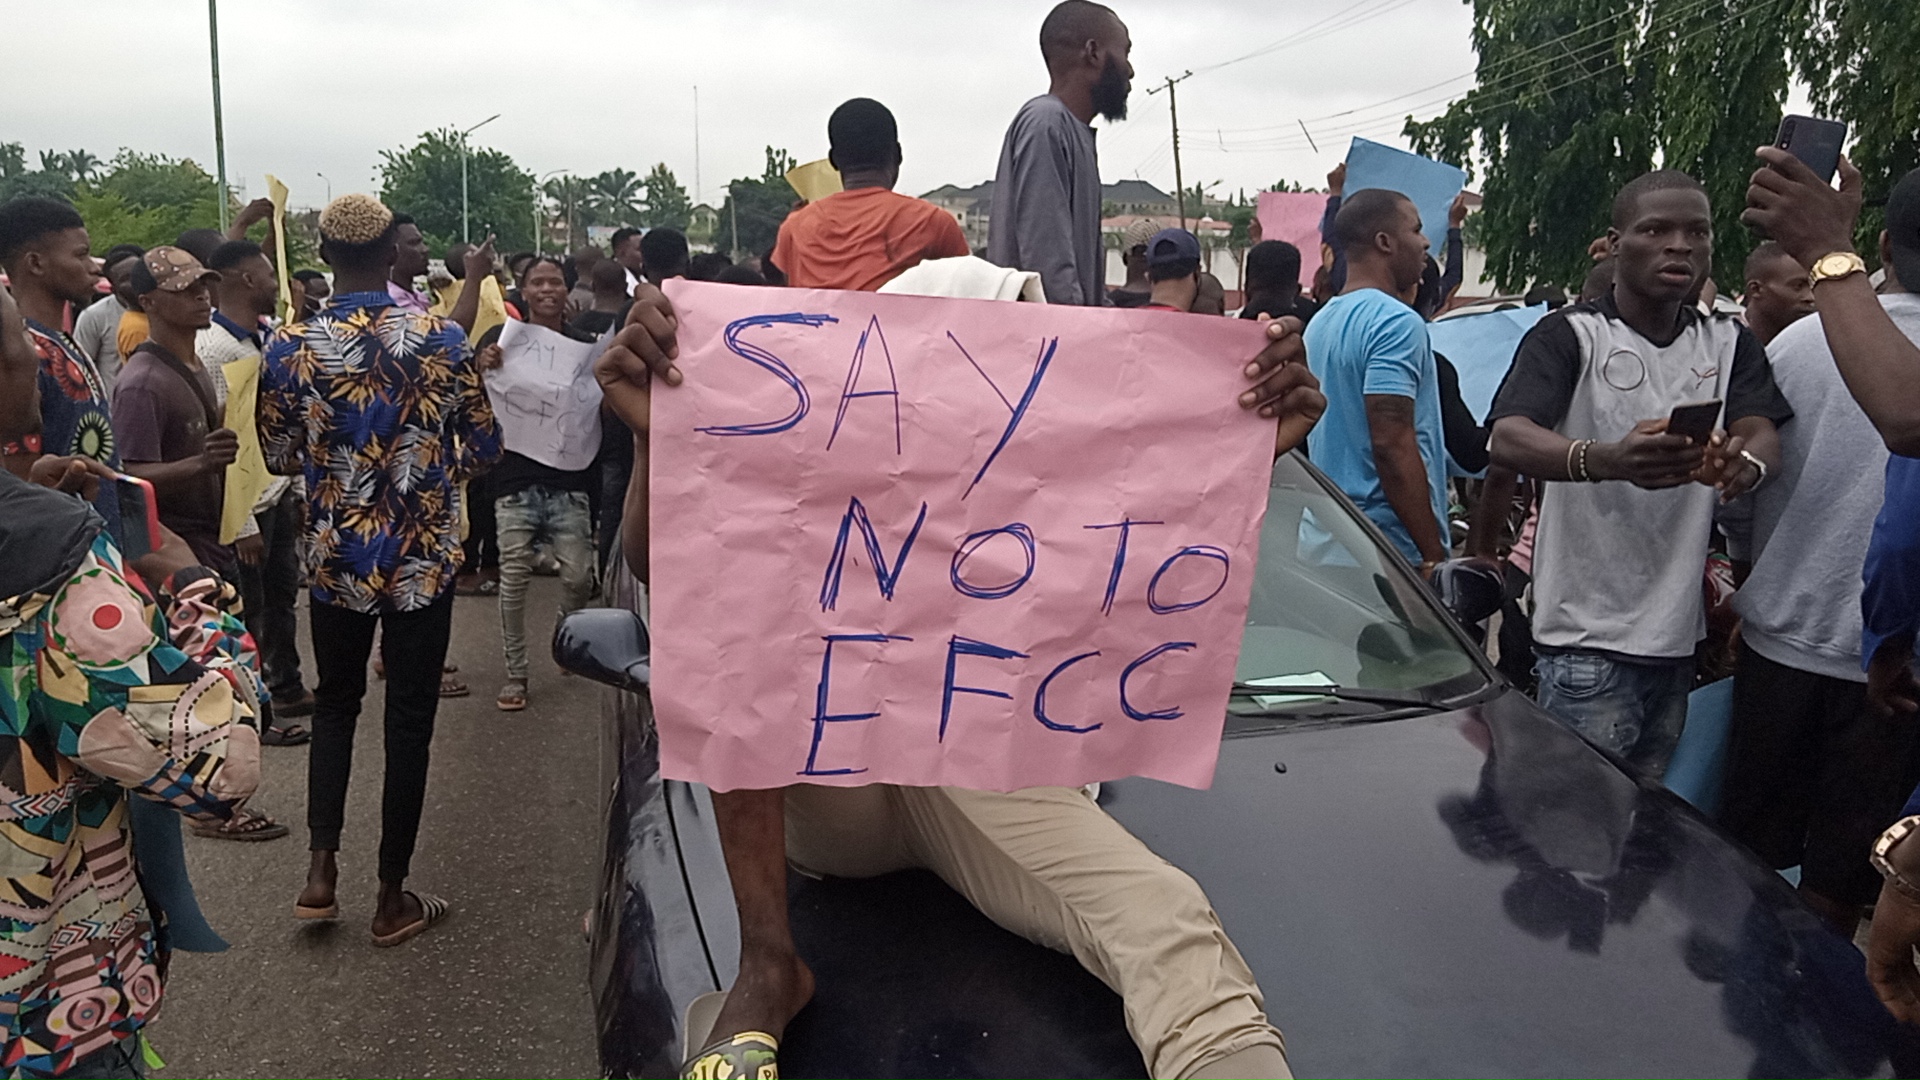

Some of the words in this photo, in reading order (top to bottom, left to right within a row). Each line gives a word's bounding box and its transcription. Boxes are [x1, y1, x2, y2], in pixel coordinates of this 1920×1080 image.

[694, 312, 1059, 500] SAY
[820, 496, 1036, 612] NO
[796, 633, 1197, 776] EFCC
